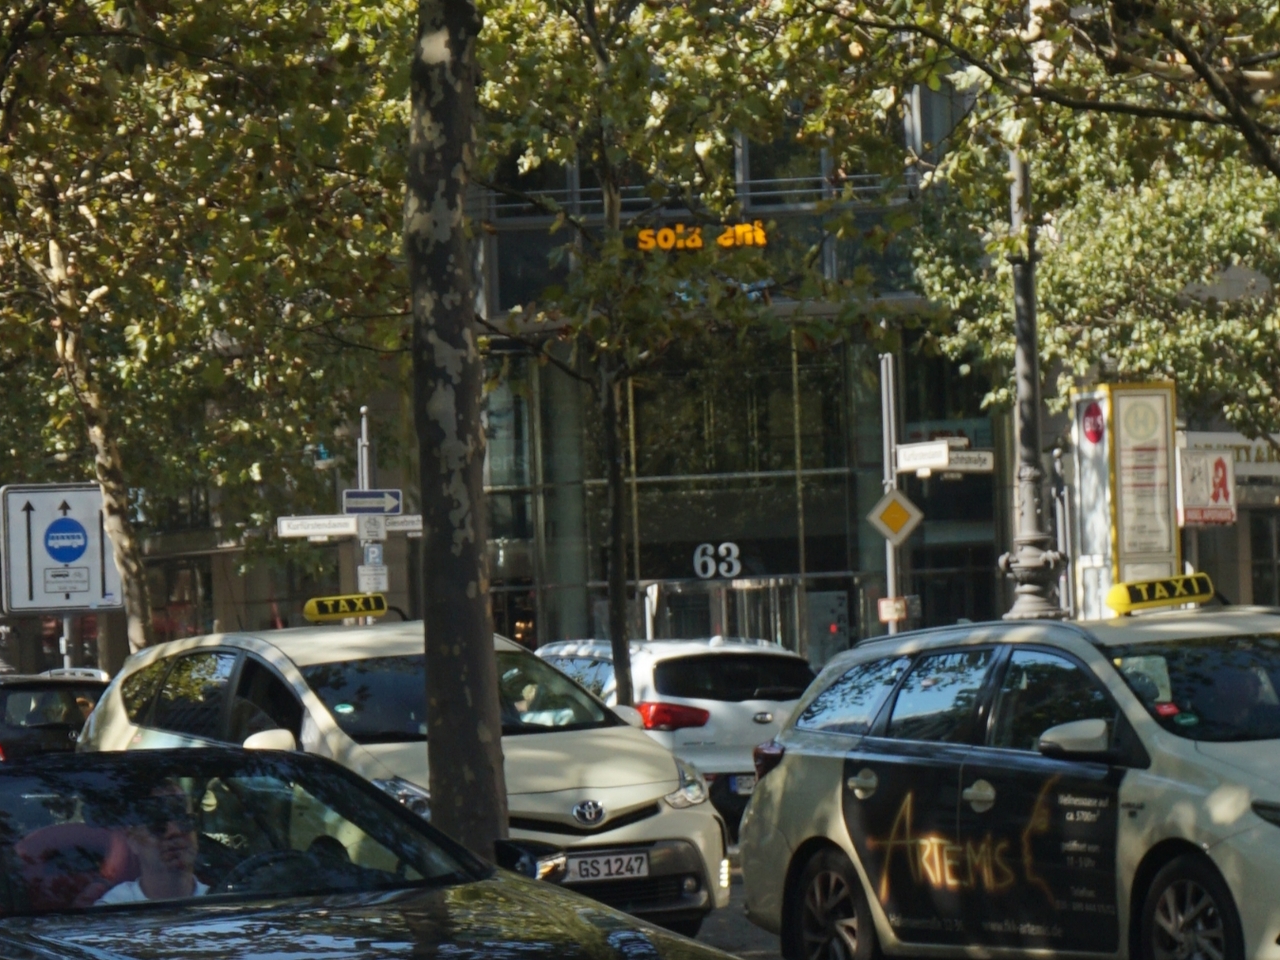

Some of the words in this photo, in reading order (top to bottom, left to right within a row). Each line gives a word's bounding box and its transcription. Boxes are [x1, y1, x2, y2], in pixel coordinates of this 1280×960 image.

[693, 542, 742, 579] 63
[1136, 578, 1200, 600] TAXI
[323, 598, 376, 613] TAXI
